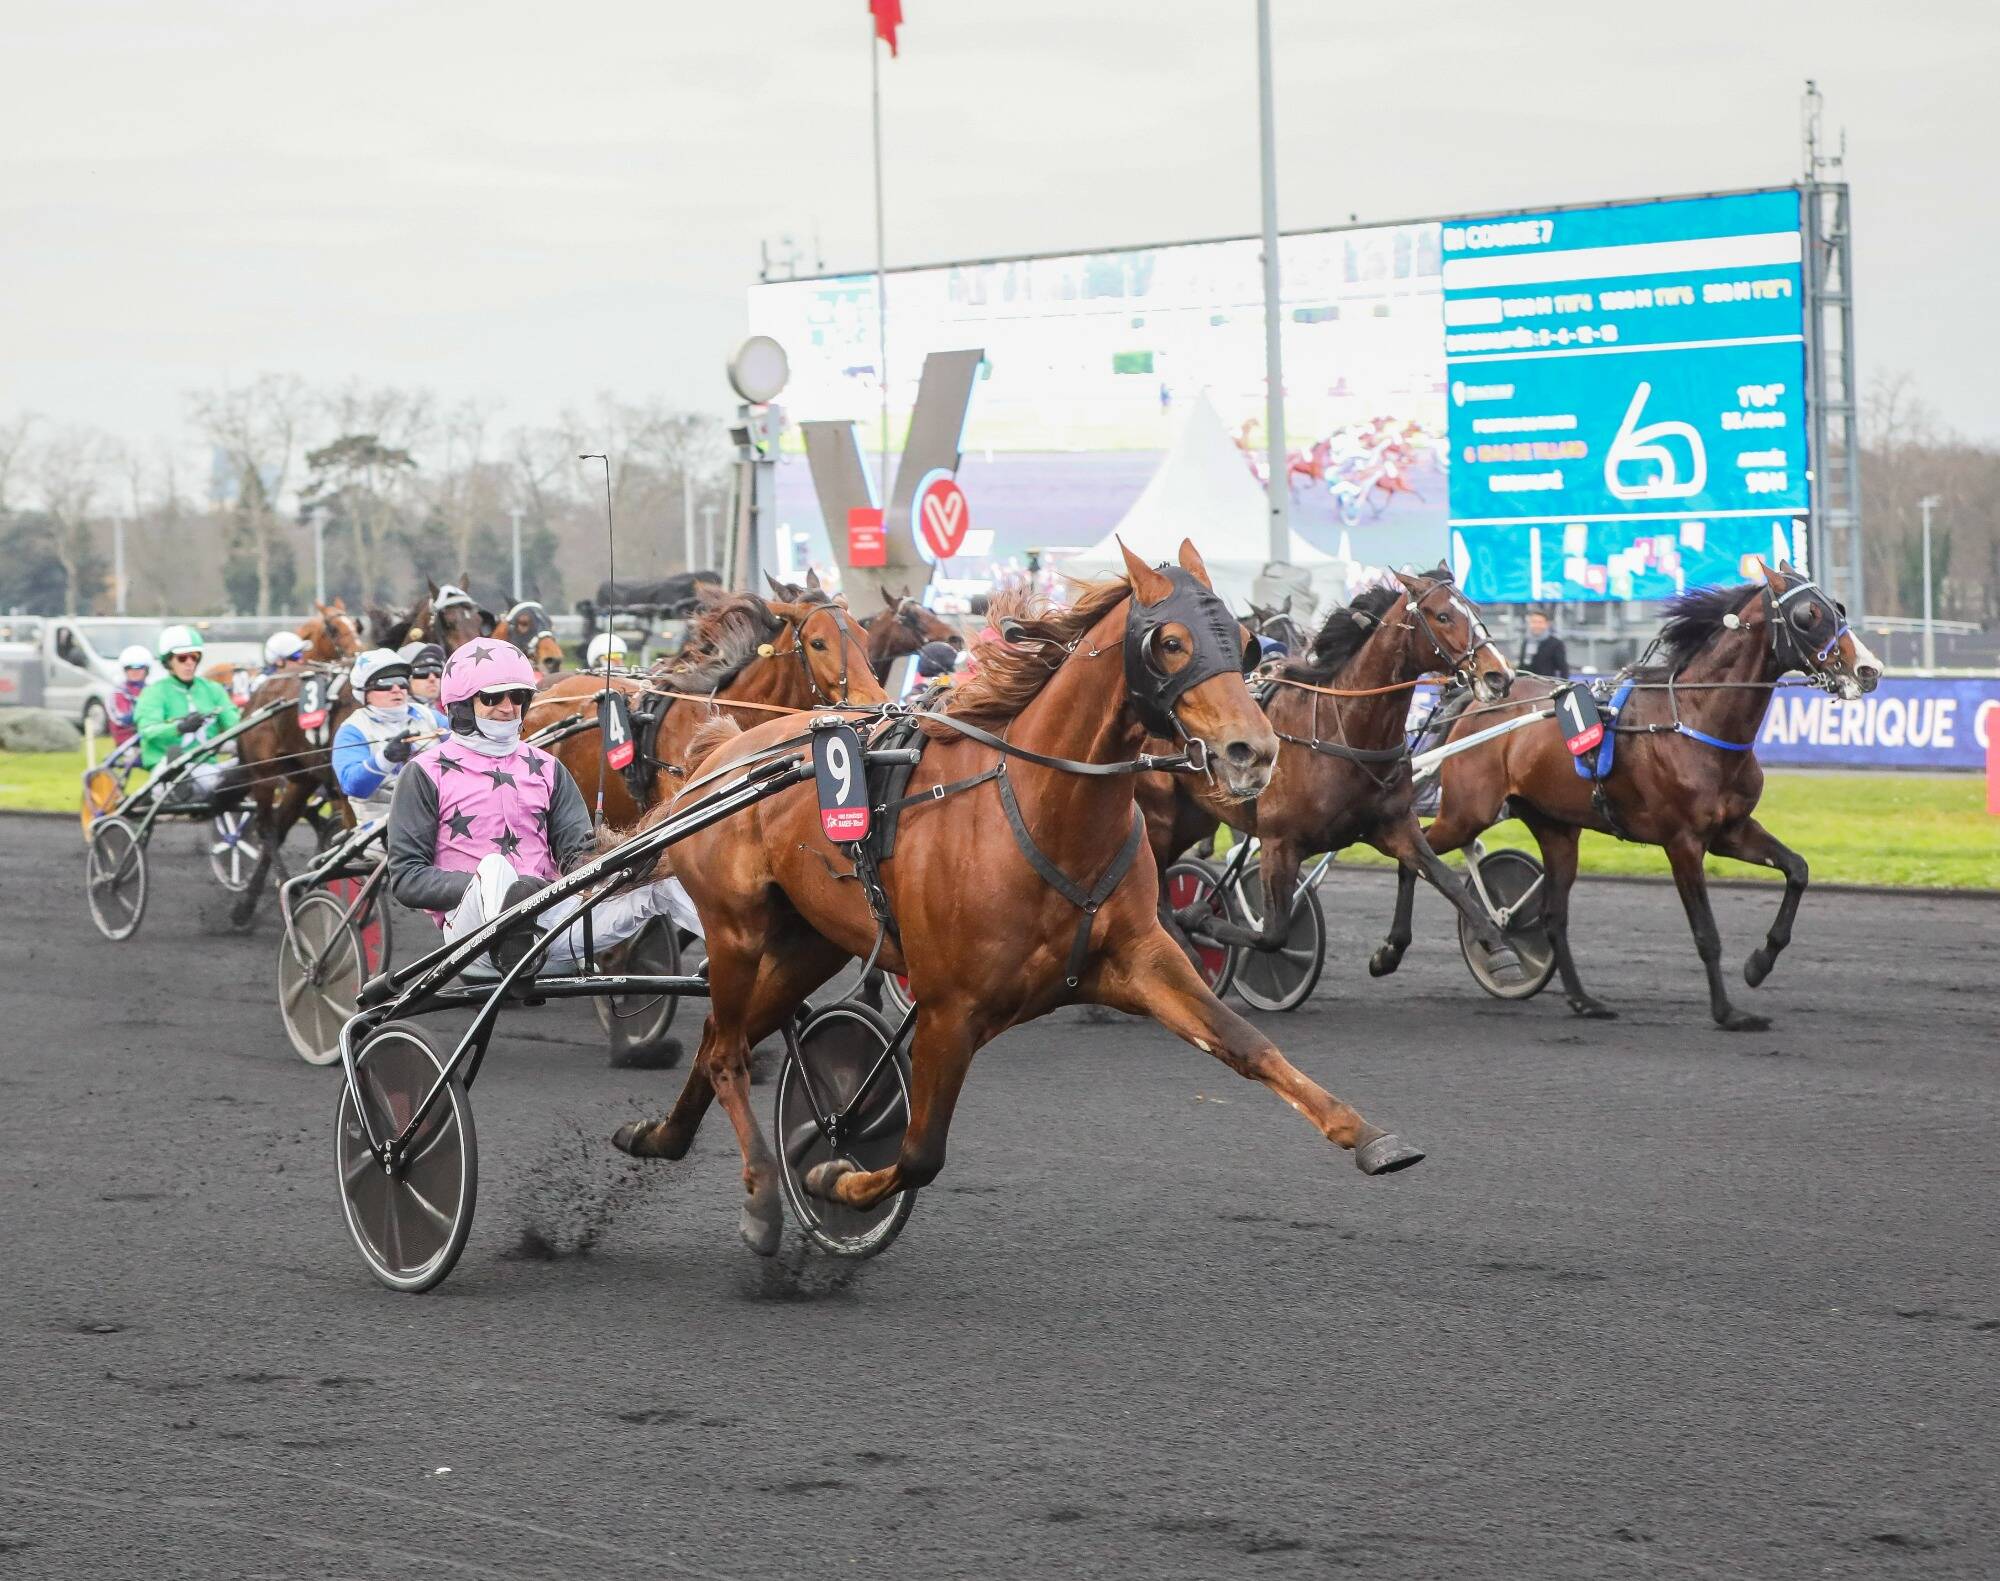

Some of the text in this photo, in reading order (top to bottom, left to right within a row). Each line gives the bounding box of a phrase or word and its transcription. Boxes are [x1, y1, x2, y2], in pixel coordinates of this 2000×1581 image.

[303, 680, 319, 713] 3
[1563, 691, 1586, 733] 1
[609, 700, 625, 745] 4
[826, 736, 852, 806] 9
